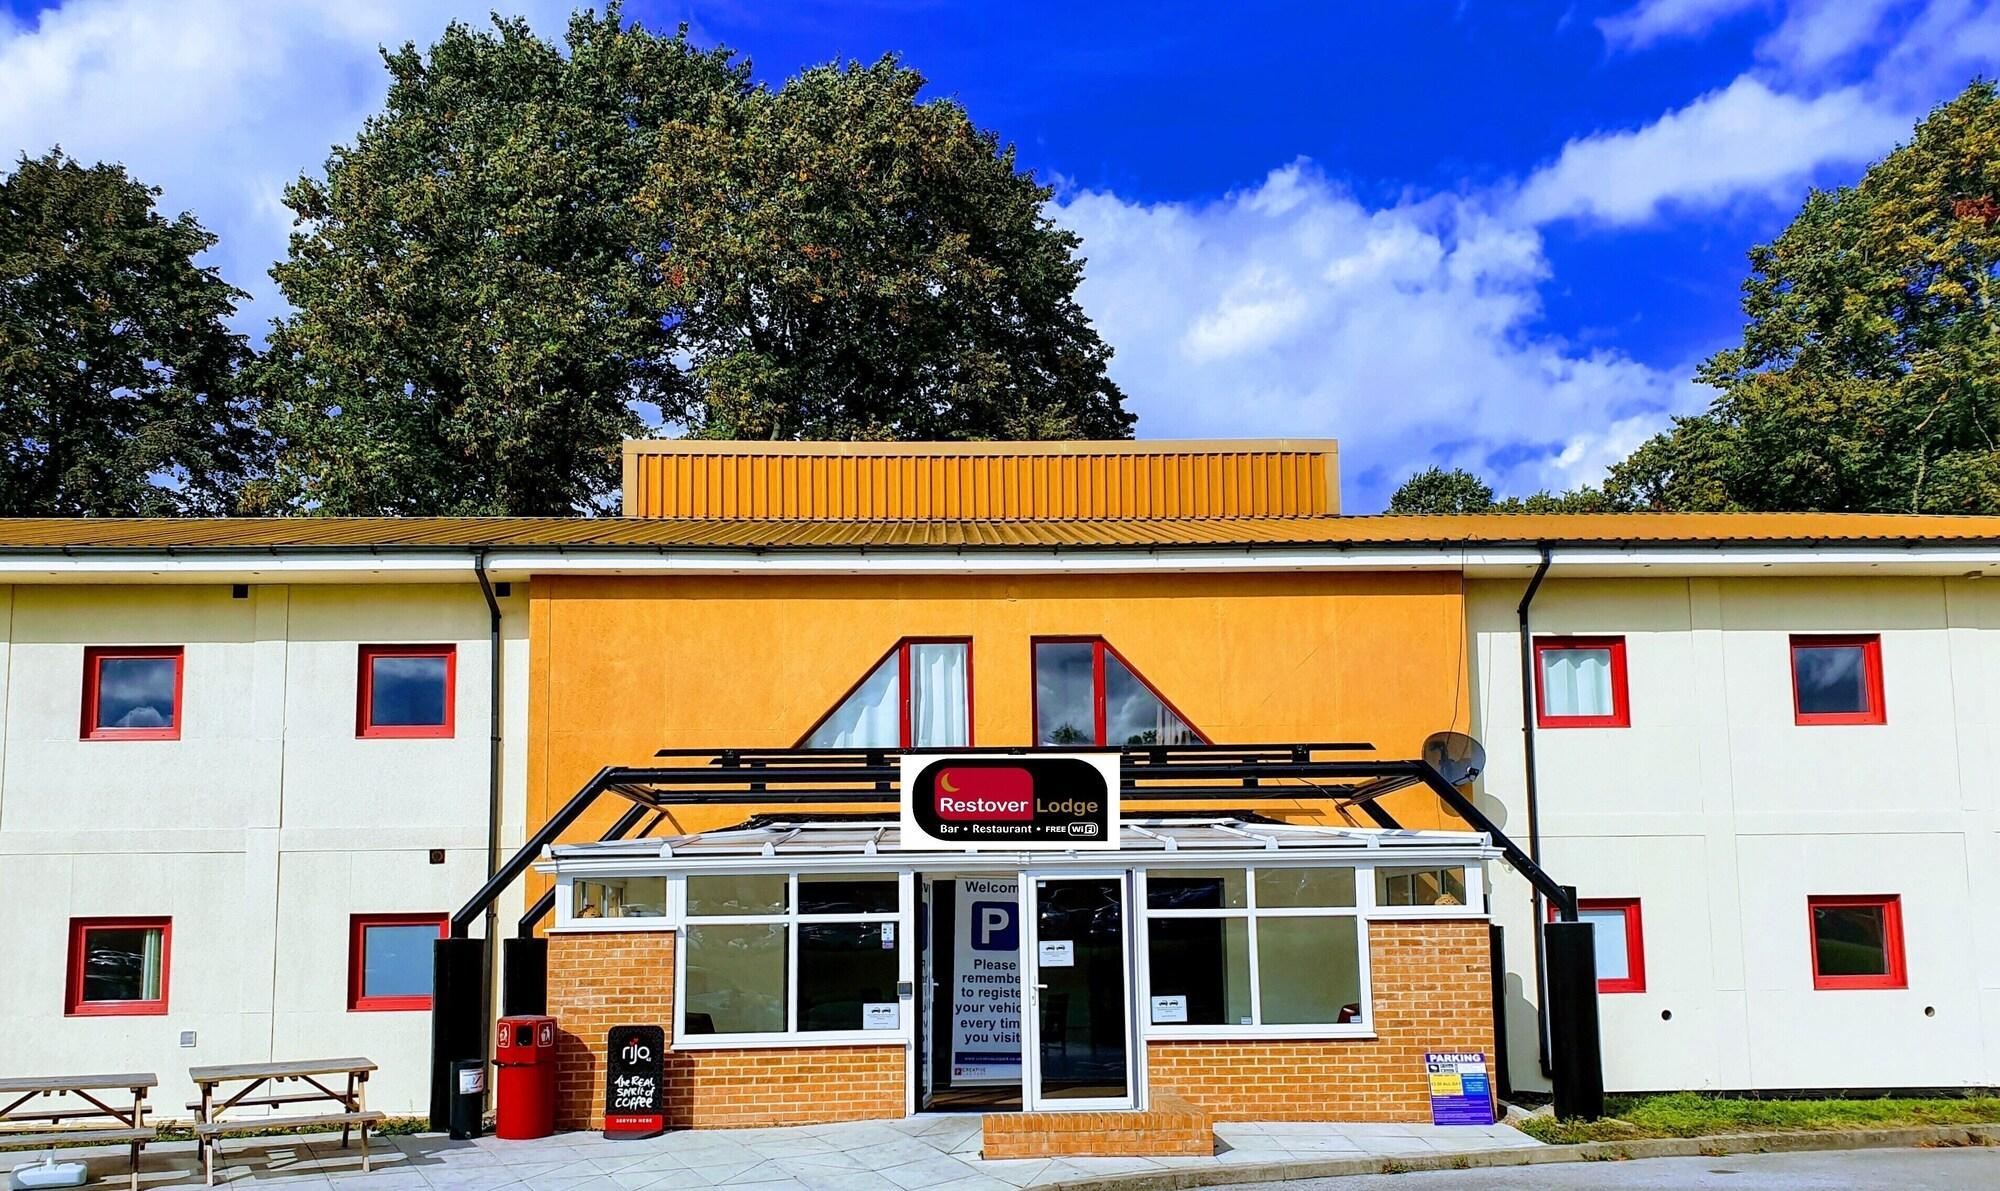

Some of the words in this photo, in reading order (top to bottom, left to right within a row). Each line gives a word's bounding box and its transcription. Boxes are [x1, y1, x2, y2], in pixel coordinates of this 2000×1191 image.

[940, 797, 1028, 813] Restover
[1036, 798, 1098, 816] Lodge
[940, 824, 959, 833] Bar
[972, 824, 1032, 833] Restaurant
[965, 881, 1019, 893] Welcom
[981, 907, 1010, 944] P
[974, 959, 1017, 970] Please
[962, 973, 1021, 984] remembe
[961, 987, 974, 998] to
[978, 987, 1021, 1000] registe
[955, 1003, 985, 1015] your
[988, 1002, 1021, 1013] vehic
[960, 1019, 996, 1031] every
[1000, 1018, 1020, 1029] tim
[964, 1033, 989, 1045] you
[992, 1032, 1021, 1043] visit
[622, 1040, 650, 1065] rijo
[1429, 1054, 1482, 1063] PARKING
[631, 1076, 655, 1088] REAL
[645, 1087, 656, 1098] of
